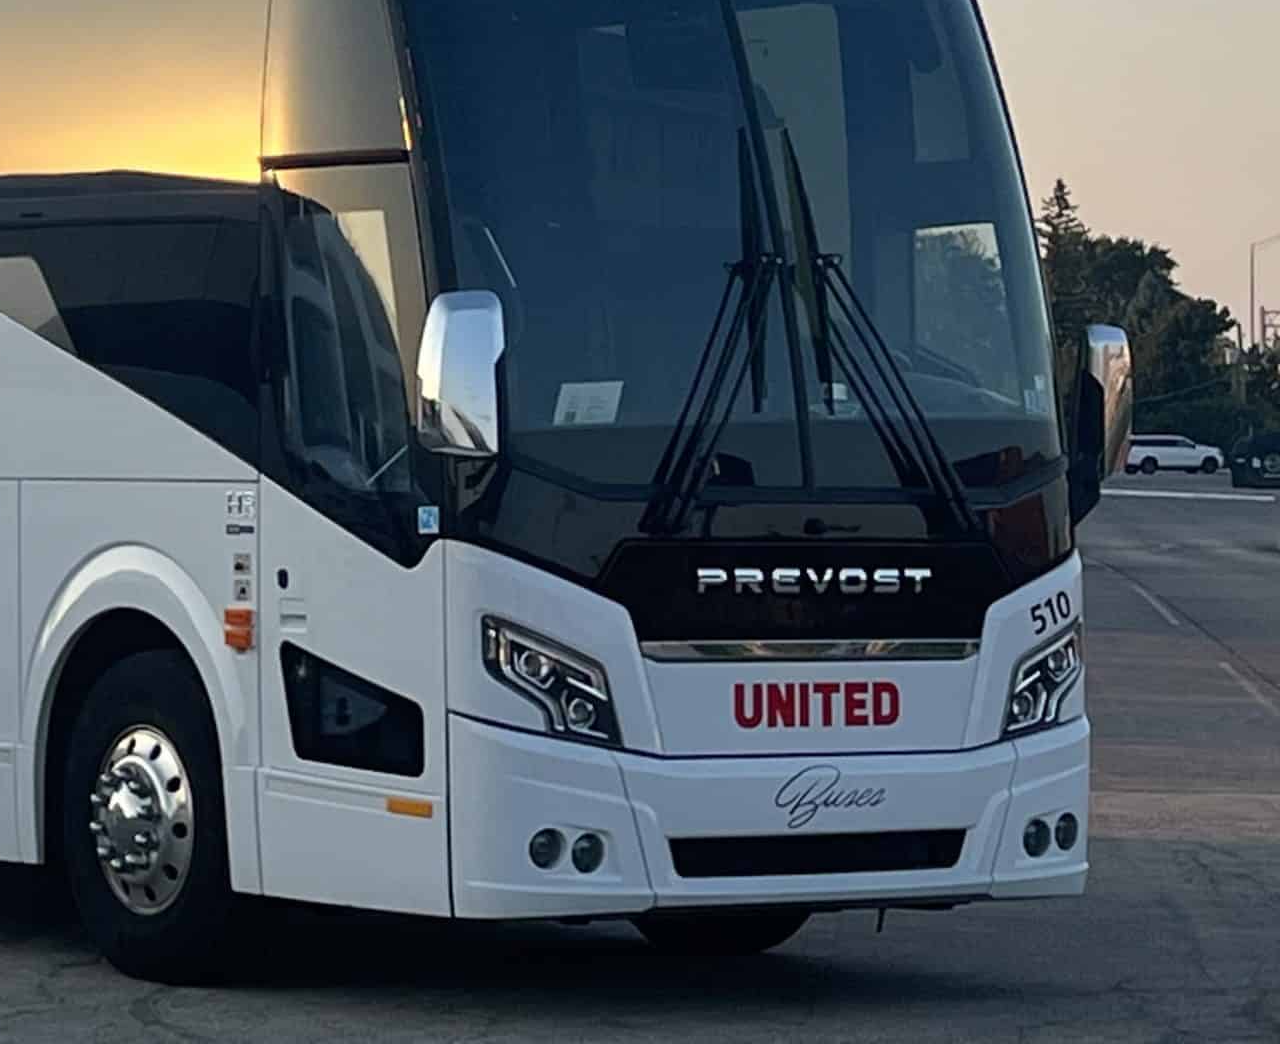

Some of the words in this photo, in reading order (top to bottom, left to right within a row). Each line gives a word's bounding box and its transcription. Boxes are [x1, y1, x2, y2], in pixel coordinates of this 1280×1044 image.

[696, 567, 933, 595] PREVOST
[1029, 590, 1071, 636] 510
[734, 682, 901, 729] UNITED
[774, 764, 887, 829] Buses
